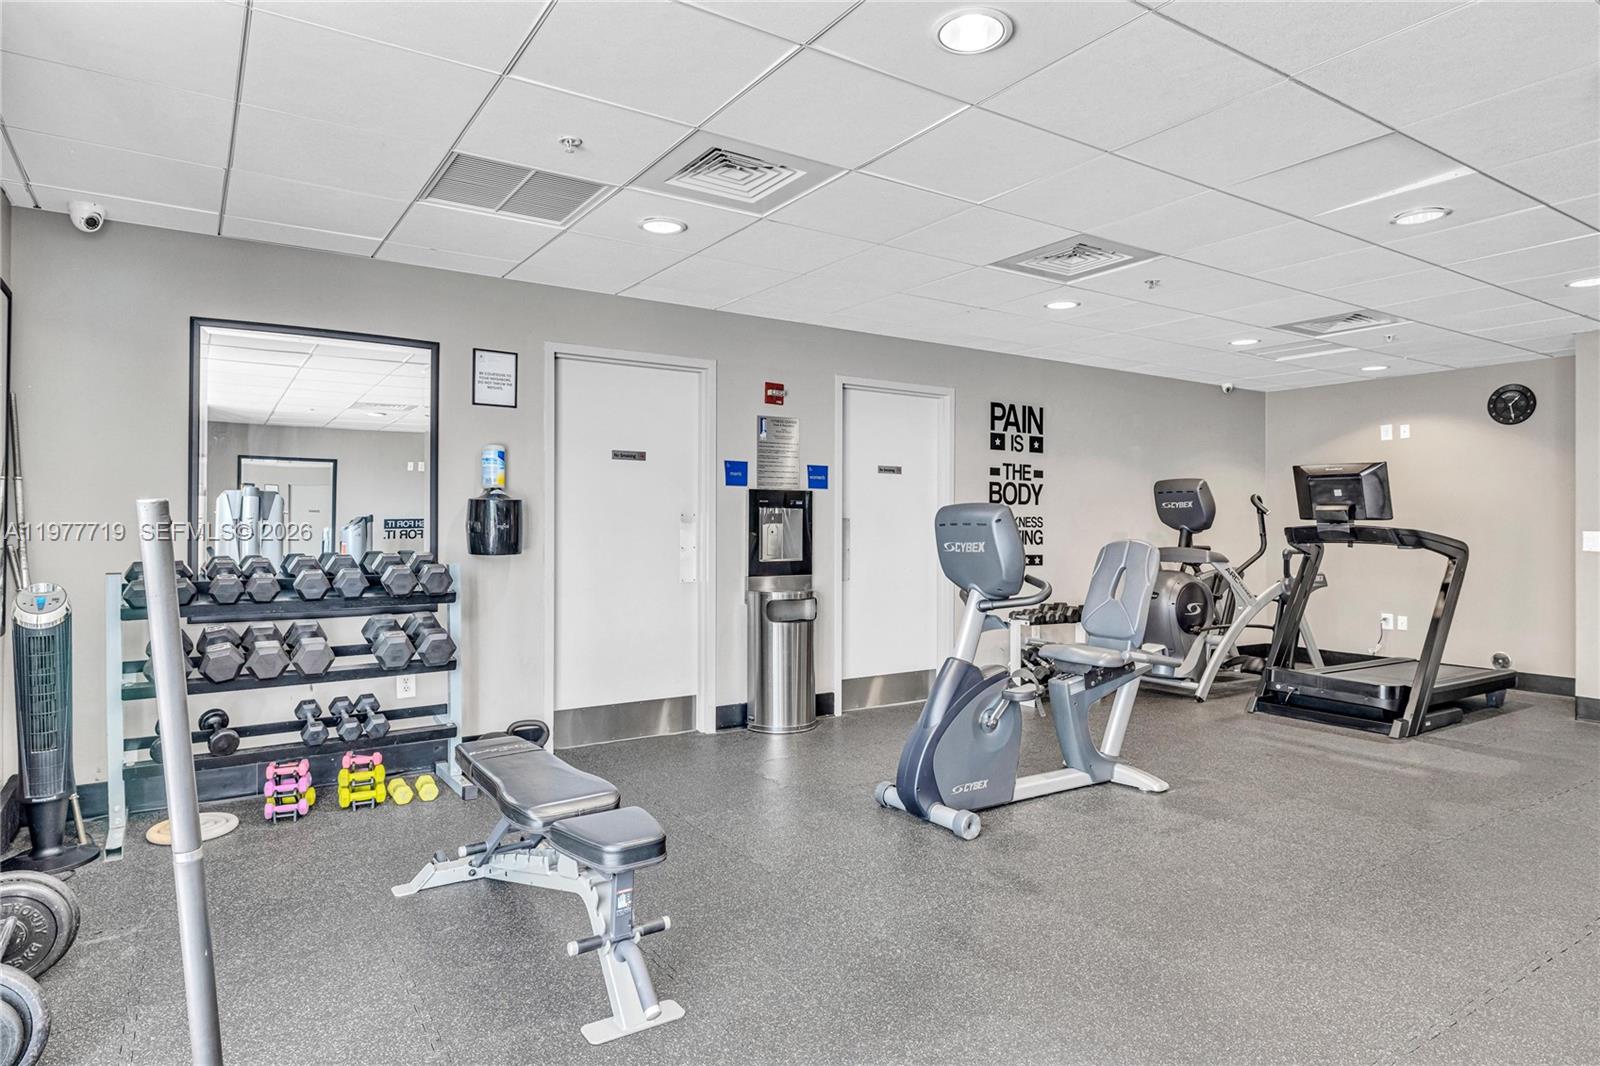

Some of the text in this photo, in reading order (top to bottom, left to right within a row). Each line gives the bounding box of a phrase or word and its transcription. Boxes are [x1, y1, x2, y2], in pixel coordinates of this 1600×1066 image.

[990, 402, 1044, 435] PAIN
[1011, 434, 1024, 452] IS
[1002, 463, 1031, 481] THE
[989, 481, 1044, 505] BODY
[1019, 529, 1044, 545] ING
[954, 541, 985, 552] CYBEX
[963, 779, 989, 792] CYBEX
